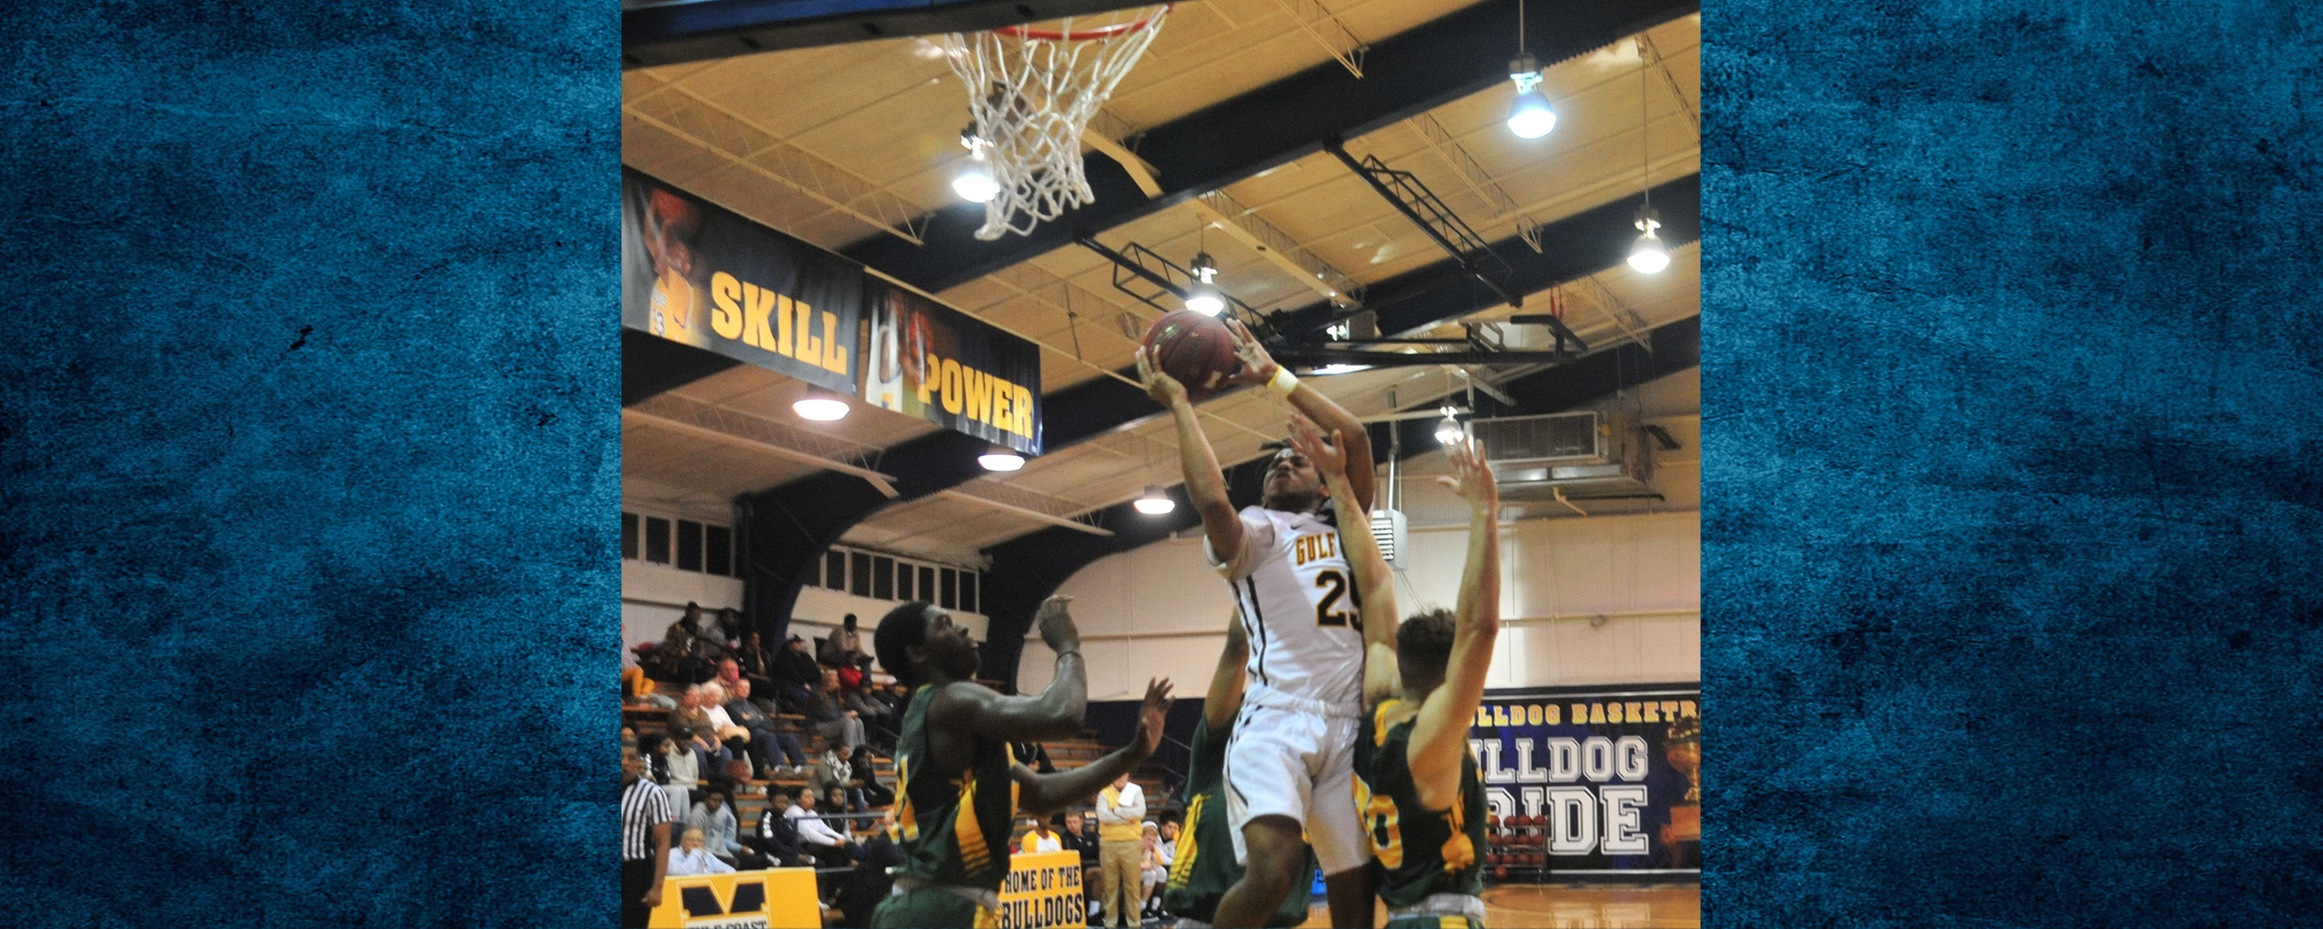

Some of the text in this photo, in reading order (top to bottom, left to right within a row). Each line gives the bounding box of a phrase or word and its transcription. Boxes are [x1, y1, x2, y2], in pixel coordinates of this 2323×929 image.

[710, 271, 847, 375] SKILL
[917, 352, 1033, 439] POWER
[1296, 532, 1335, 566] GULF
[1469, 703, 1560, 727] LLDOG
[1468, 736, 1648, 783] LLDOG
[1005, 866, 1080, 893] HOME OF THE
[1001, 893, 1083, 929] BULLDOGS
